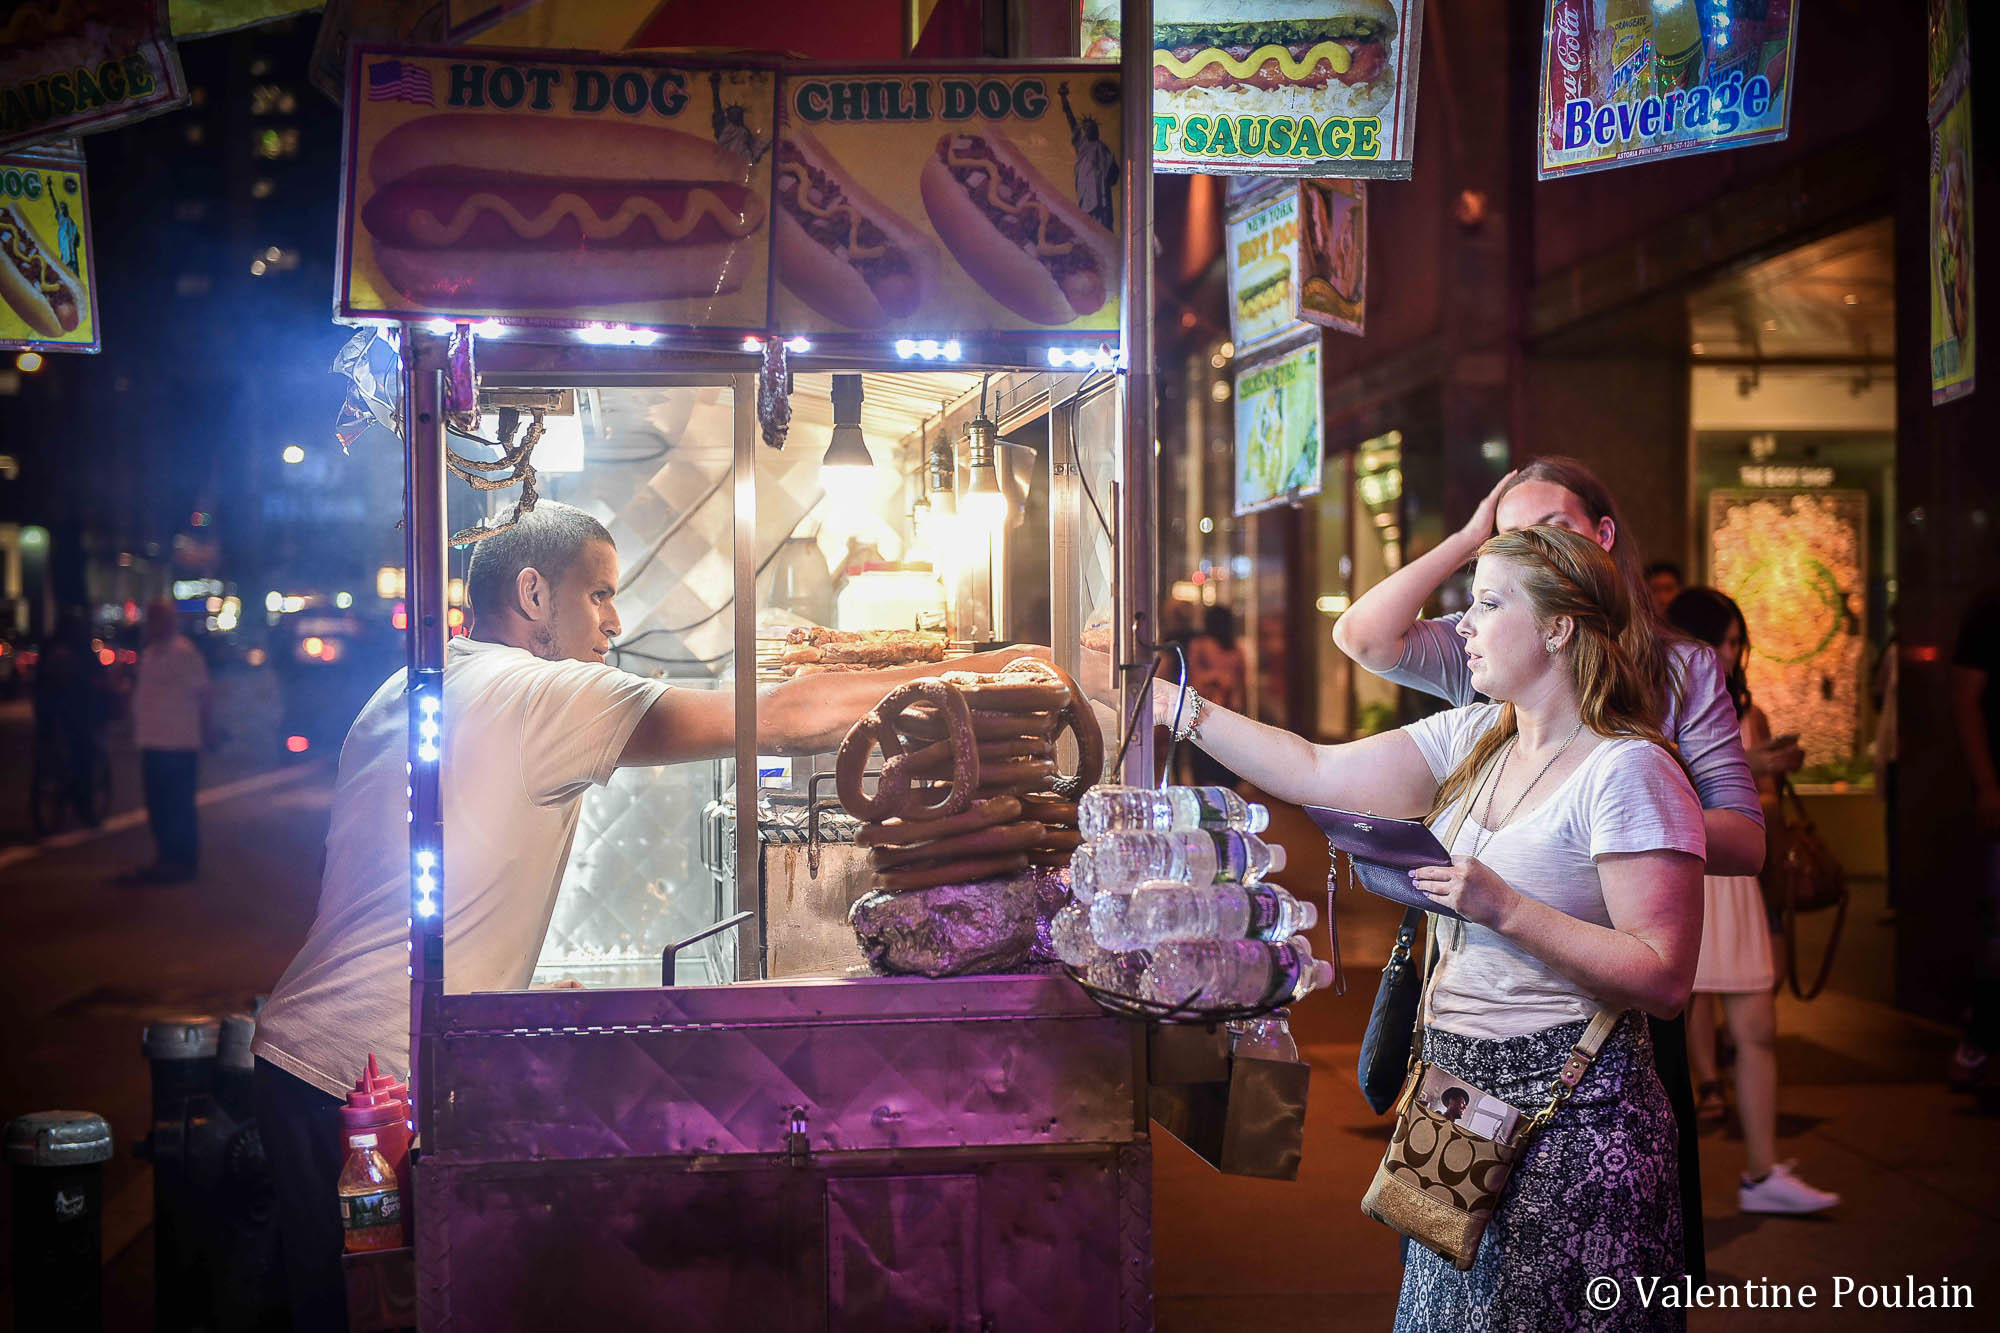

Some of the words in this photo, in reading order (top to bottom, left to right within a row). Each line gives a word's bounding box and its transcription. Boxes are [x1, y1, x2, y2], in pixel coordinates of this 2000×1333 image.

[447, 62, 561, 112] HOT
[570, 70, 691, 118] DOG
[795, 79, 932, 123] CHILI
[940, 77, 1049, 121] DOG
[1563, 71, 1770, 150] Beverage
[1180, 113, 1382, 160] SAUSAGE
[0, 169, 42, 200] OG
[1247, 214, 1267, 233] NEW
[1270, 200, 1294, 224] YORK
[1239, 231, 1269, 268] HOT
